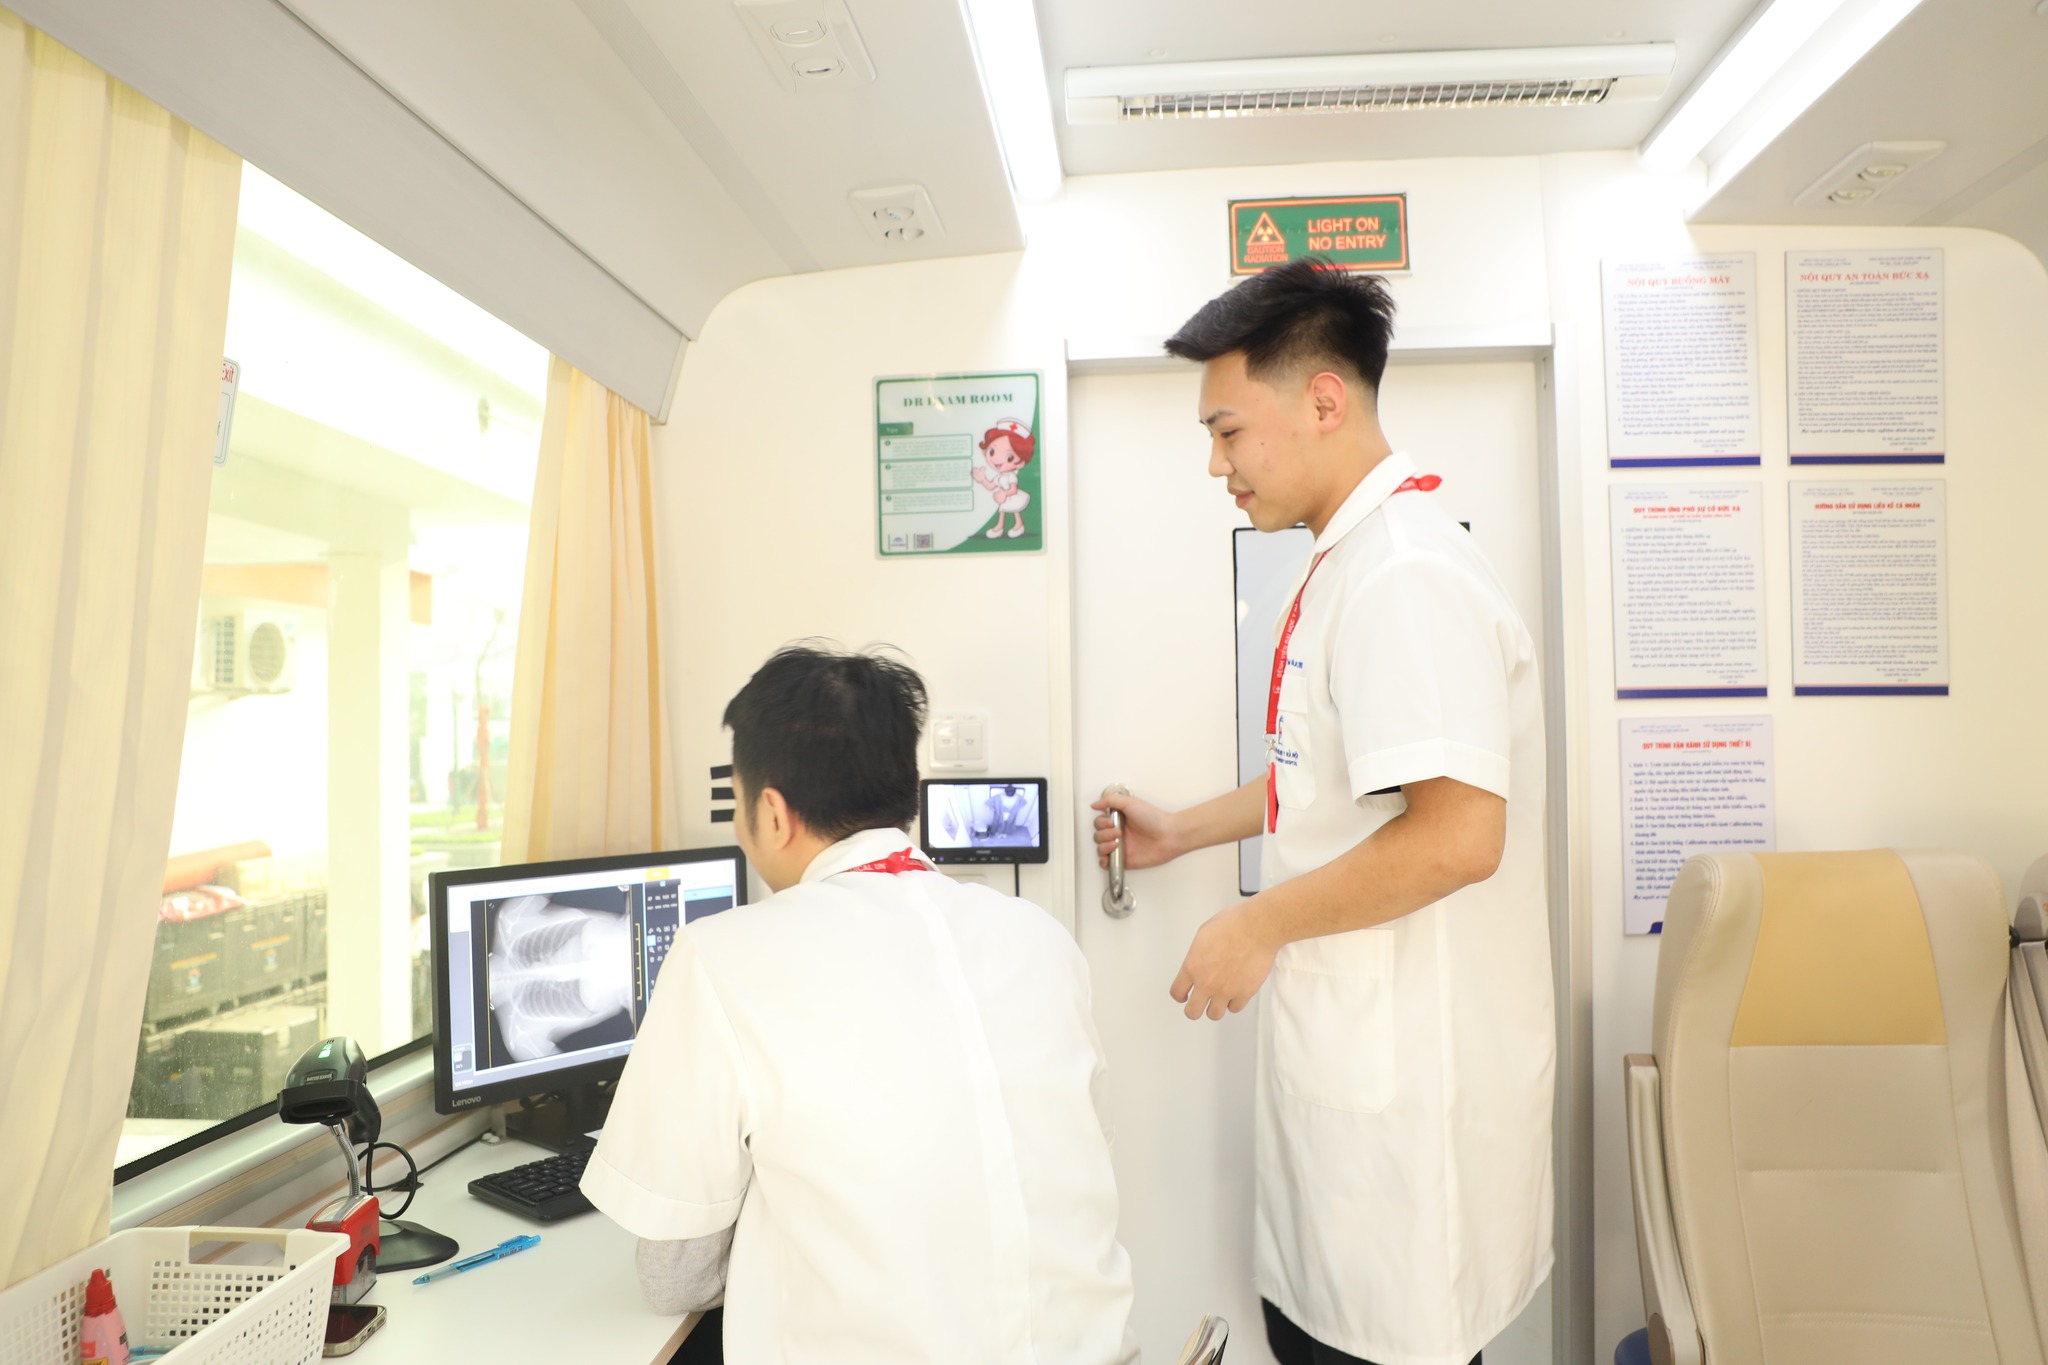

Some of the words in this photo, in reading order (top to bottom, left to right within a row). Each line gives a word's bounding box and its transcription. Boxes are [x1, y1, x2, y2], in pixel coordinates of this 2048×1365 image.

[1307, 217, 1353, 233] LIGHT
[1355, 216, 1379, 231] ON
[1308, 236, 1332, 250] NO
[1335, 234, 1387, 250] ENTRY
[1247, 245, 1285, 254] CAUTION
[1244, 253, 1289, 263] RADIATION
[1821, 273, 1842, 283] QUY
[1845, 272, 1859, 281] AN
[904, 397, 923, 407] DR
[970, 393, 1013, 404] ROOM
[452, 1096, 482, 1108] Lenovo
